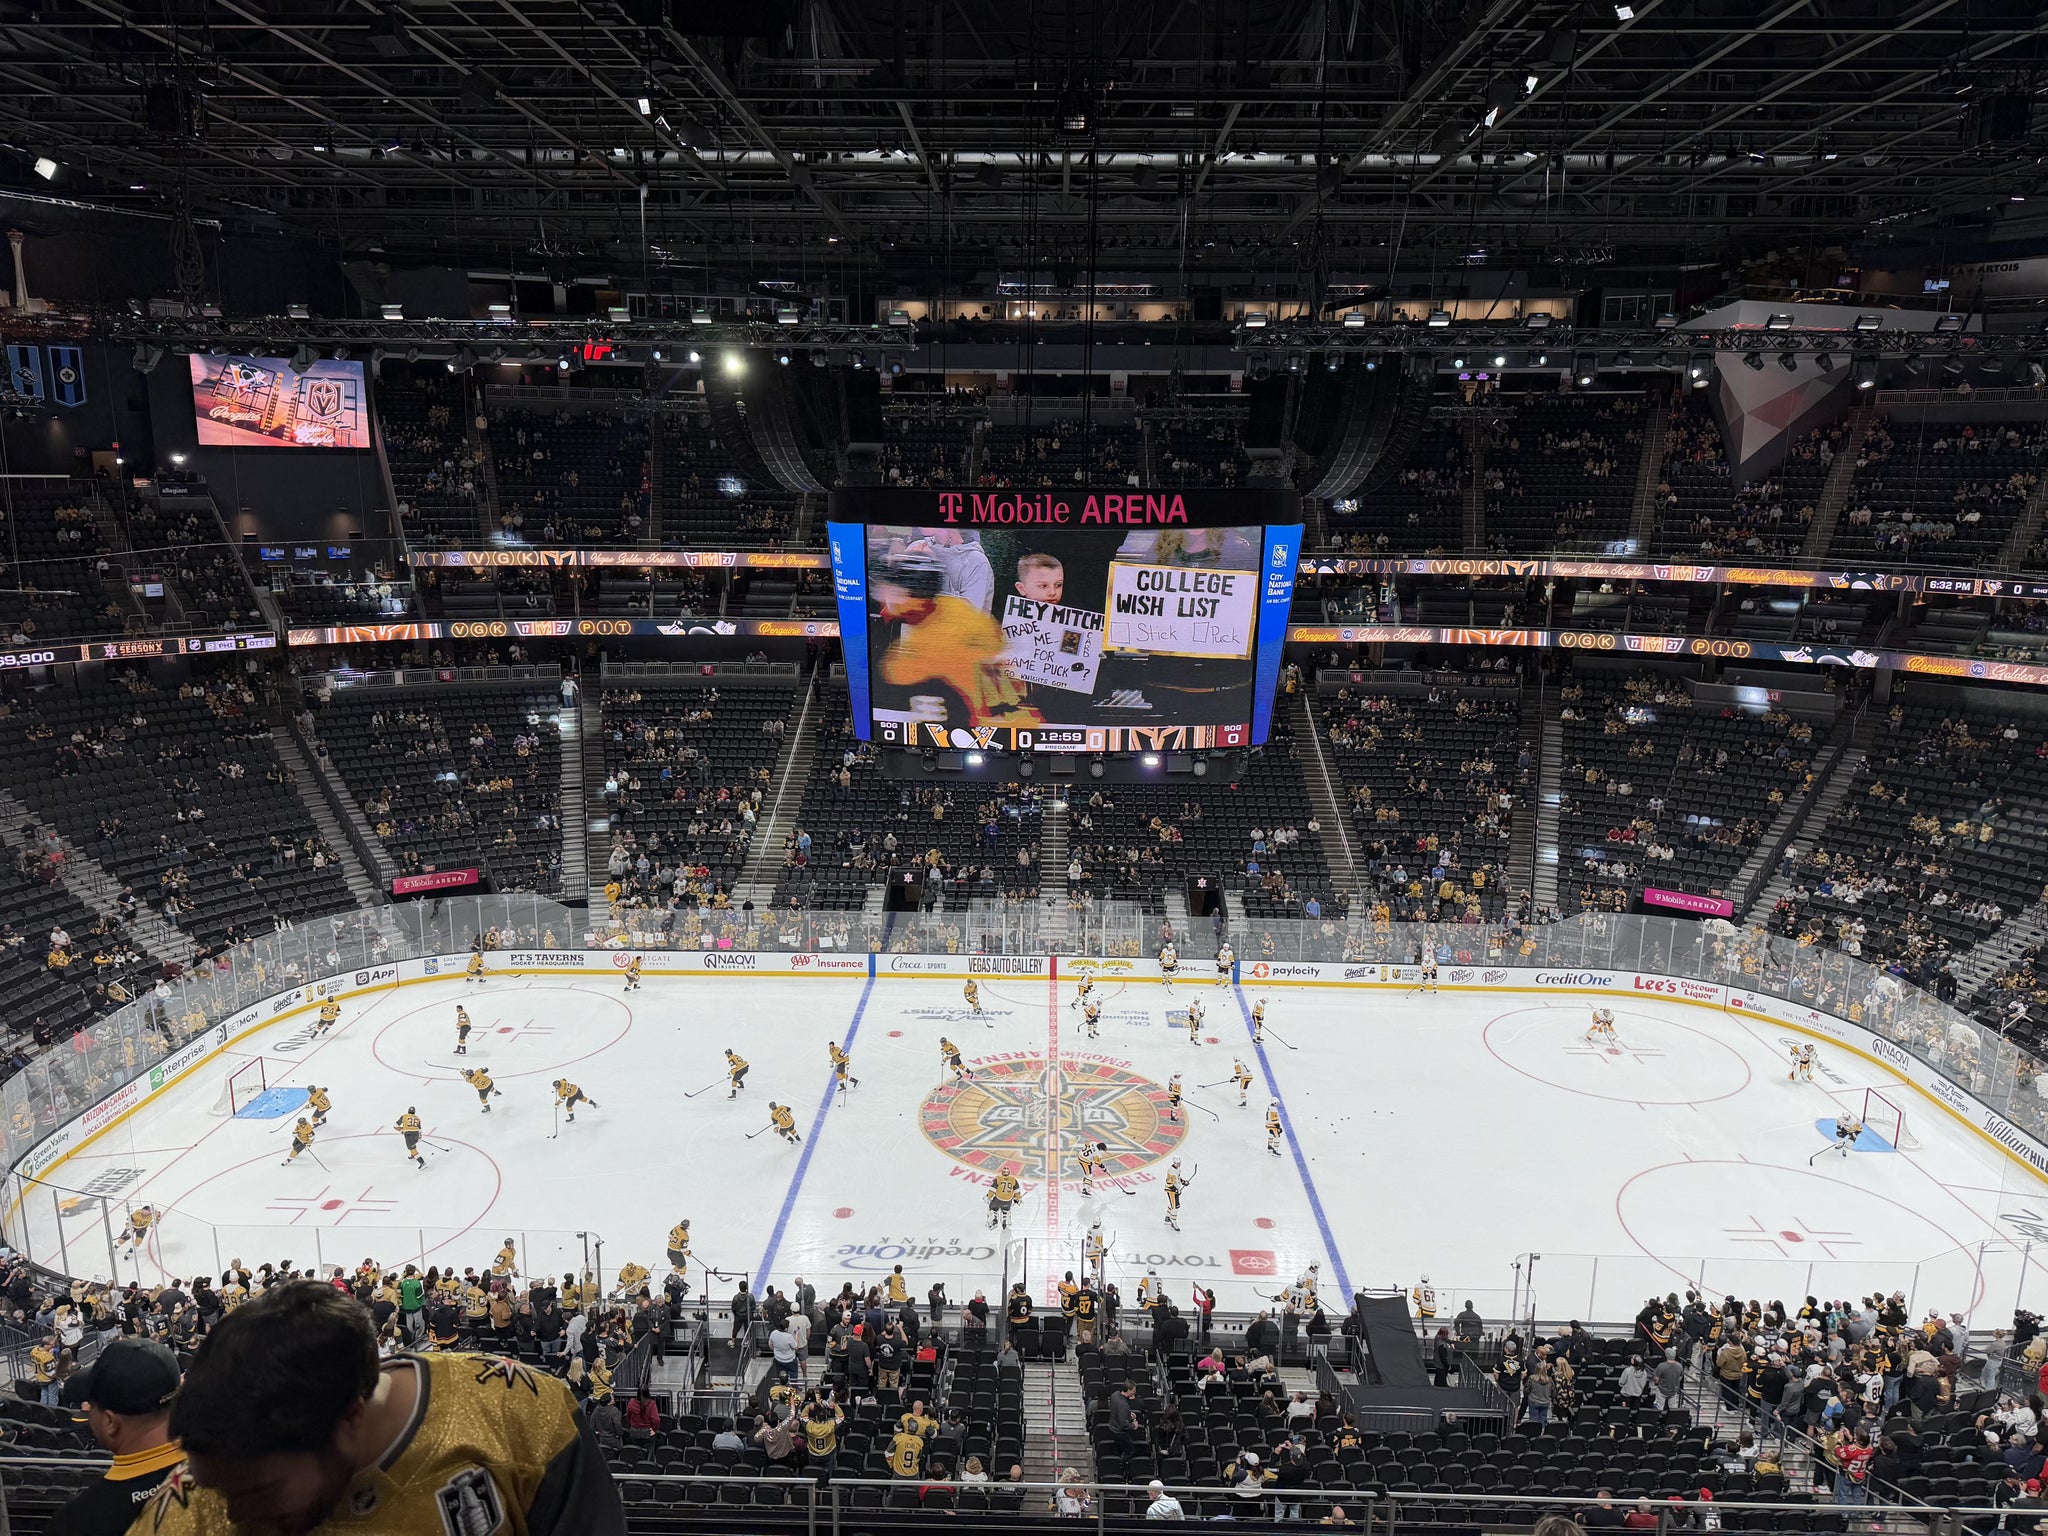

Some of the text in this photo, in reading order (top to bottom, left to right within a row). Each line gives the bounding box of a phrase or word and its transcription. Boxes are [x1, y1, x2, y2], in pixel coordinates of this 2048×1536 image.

[1977, 263, 2019, 273] ARTOIS
[970, 494, 1188, 523] Mobile ARENA
[1136, 570, 1235, 596] COLLEGE
[1929, 580, 1971, 591] 6:32 PM
[2013, 585, 2022, 594] 0
[1116, 594, 1220, 618] WISH LIST
[1008, 597, 1105, 632] HEY MITCH!
[556, 625, 566, 633] 27
[759, 622, 801, 634] Penguins
[1003, 621, 1040, 638] TRADE
[1136, 623, 1240, 644] Stick Puck
[1294, 630, 1337, 641] Penguins
[1356, 630, 1390, 641] Golden
[1393, 629, 1433, 641] Knights
[1667, 641, 1678, 650] 27
[1034, 649, 1055, 662] FOR
[1043, 663, 1069, 678] PUCK
[1908, 656, 1963, 674] Penguins
[1991, 664, 2036, 681] Golden
[884, 731, 896, 741] 0
[1019, 732, 1031, 748] 0
[1040, 732, 1082, 742] 12:59
[1090, 733, 1103, 749] 0
[1227, 733, 1238, 744] 0
[536, 954, 584, 962] TAVERNS
[718, 955, 755, 965] NAQVI
[818, 959, 863, 968] Insurance
[891, 956, 946, 972] Circa SPORTS
[968, 958, 1043, 974] VEGAS AUTO GALLERY
[1272, 966, 1320, 976] paylocity
[1535, 972, 1612, 986] CreditOne
[1634, 976, 1719, 994] Lee's Discount
[1684, 988, 1714, 1000] Liquor
[322, 1006, 335, 1015] 24
[1743, 1000, 1767, 1014] YouTube
[227, 1011, 259, 1034] BETMGM
[967, 1051, 1045, 1065] ARENA
[1883, 1042, 1910, 1067] NAQVI
[1930, 1083, 1954, 1103] AMERICA
[1953, 1099, 1969, 1114] FIRST
[84, 1122, 103, 1137] LOCALS
[1982, 1111, 2031, 1159] William
[33, 1130, 70, 1160] Green Valley
[34, 1148, 59, 1171] Grocery
[1000, 1181, 1013, 1193] 79
[838, 1244, 995, 1260] CreditOne
[1079, 1301, 1092, 1313] 87
[903, 1451, 914, 1467] 9
